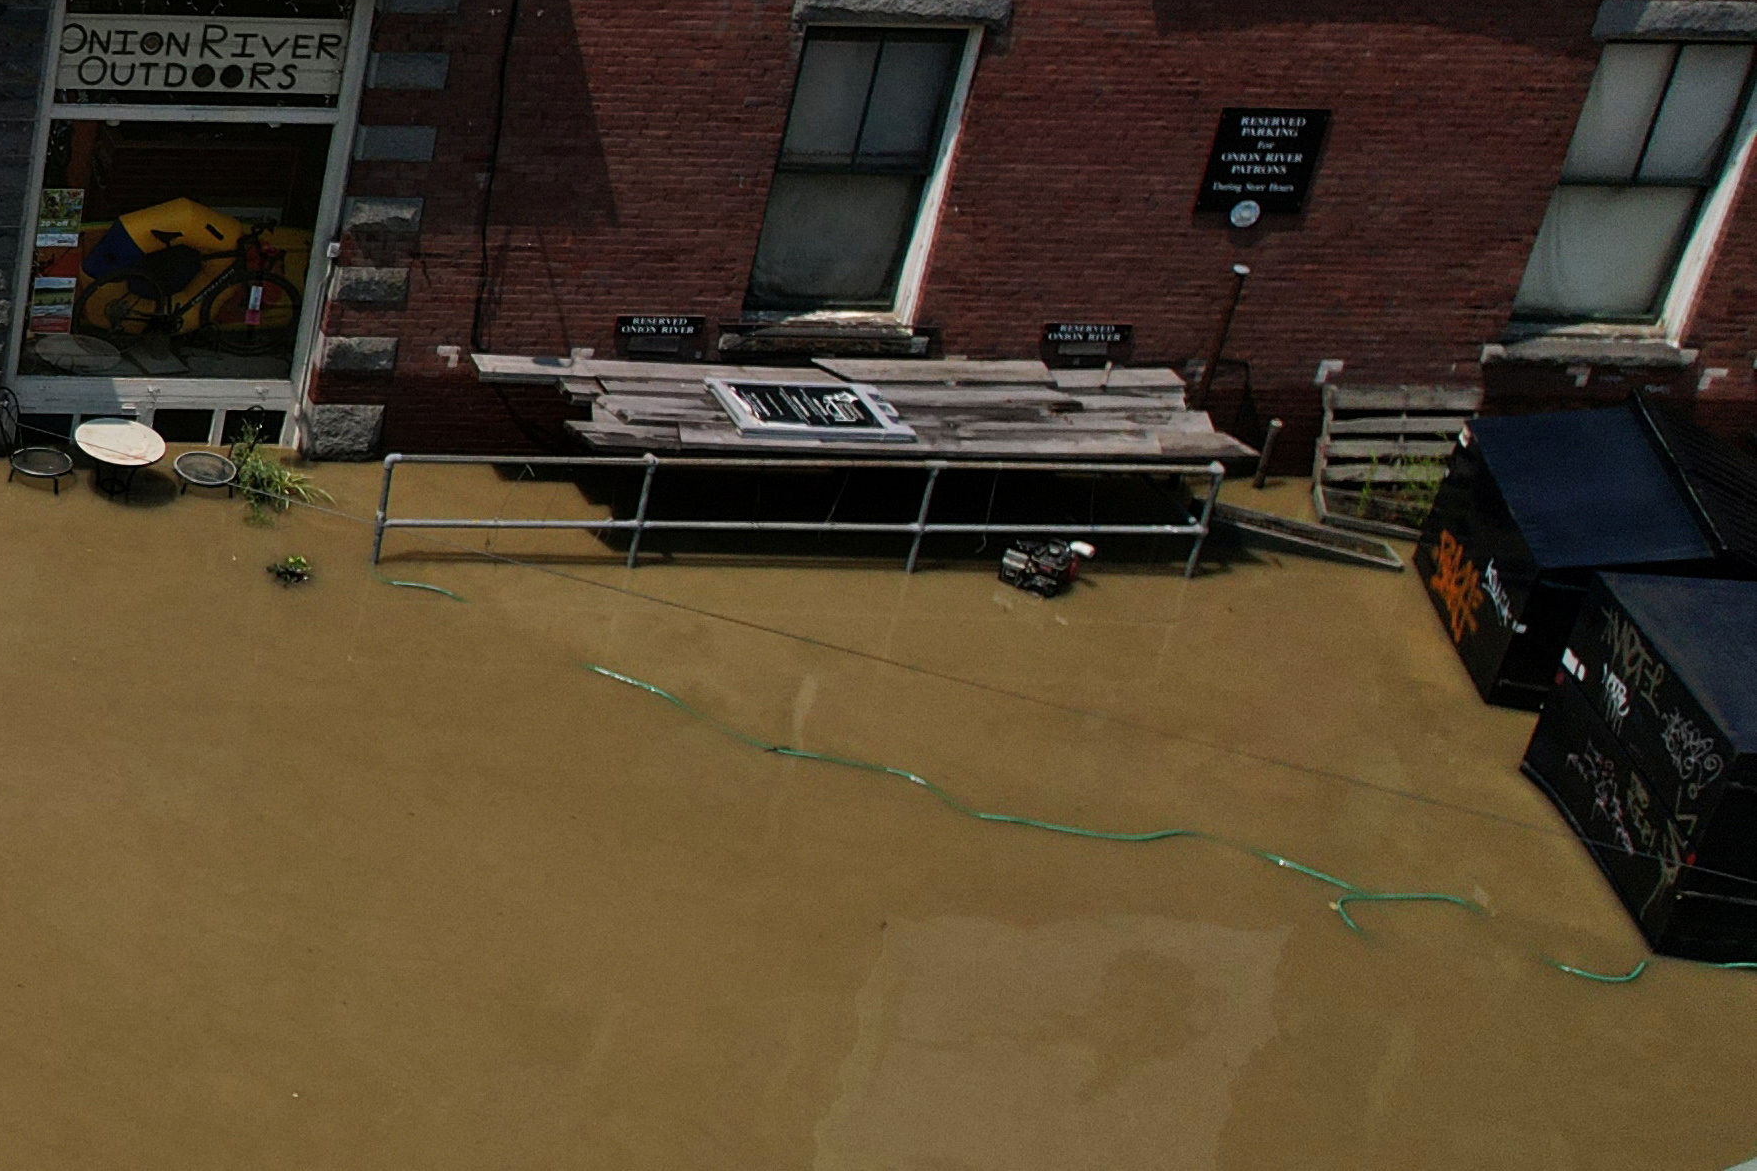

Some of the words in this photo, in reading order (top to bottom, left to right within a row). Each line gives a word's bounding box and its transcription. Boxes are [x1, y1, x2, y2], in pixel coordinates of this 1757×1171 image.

[60, 22, 190, 58] ONION
[199, 24, 342, 60] RIVER
[78, 55, 299, 90] OUTDOORS
[1241, 116, 1307, 127] RESERVED
[1241, 127, 1299, 137] PARKING
[1221, 152, 1261, 162] ONION
[1265, 153, 1303, 163] RIVER
[1231, 165, 1287, 175] PATRONS
[632, 317, 688, 326] RESERVED
[621, 325, 657, 334] ONION
[661, 326, 695, 334] RIVER
[1060, 324, 1115, 333] RESERVED
[1048, 332, 1084, 341] ONION
[1087, 333, 1121, 342] RIVER
